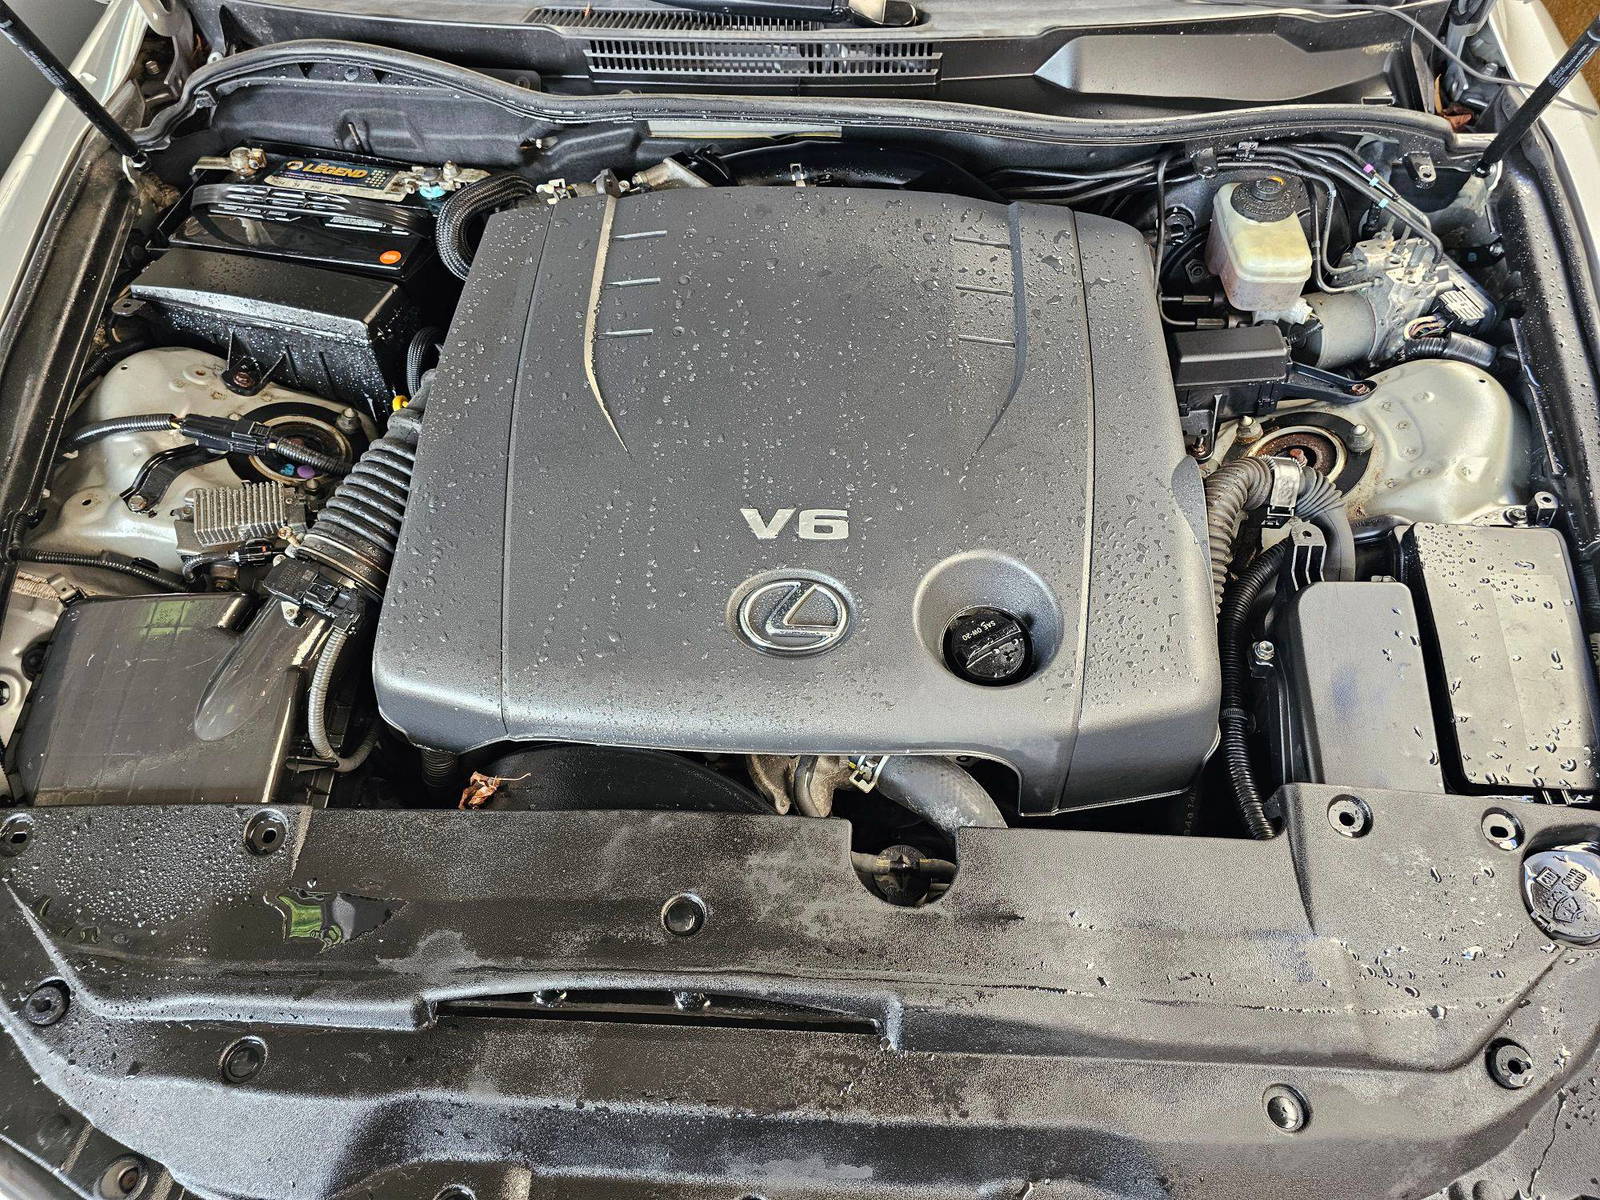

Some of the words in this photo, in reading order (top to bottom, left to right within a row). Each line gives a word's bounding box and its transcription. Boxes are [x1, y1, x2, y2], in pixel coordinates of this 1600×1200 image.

[302, 163, 368, 178] LEGEND
[740, 508, 849, 539] V6
[982, 620, 996, 630] SAE
[961, 627, 982, 641] 0W-20
